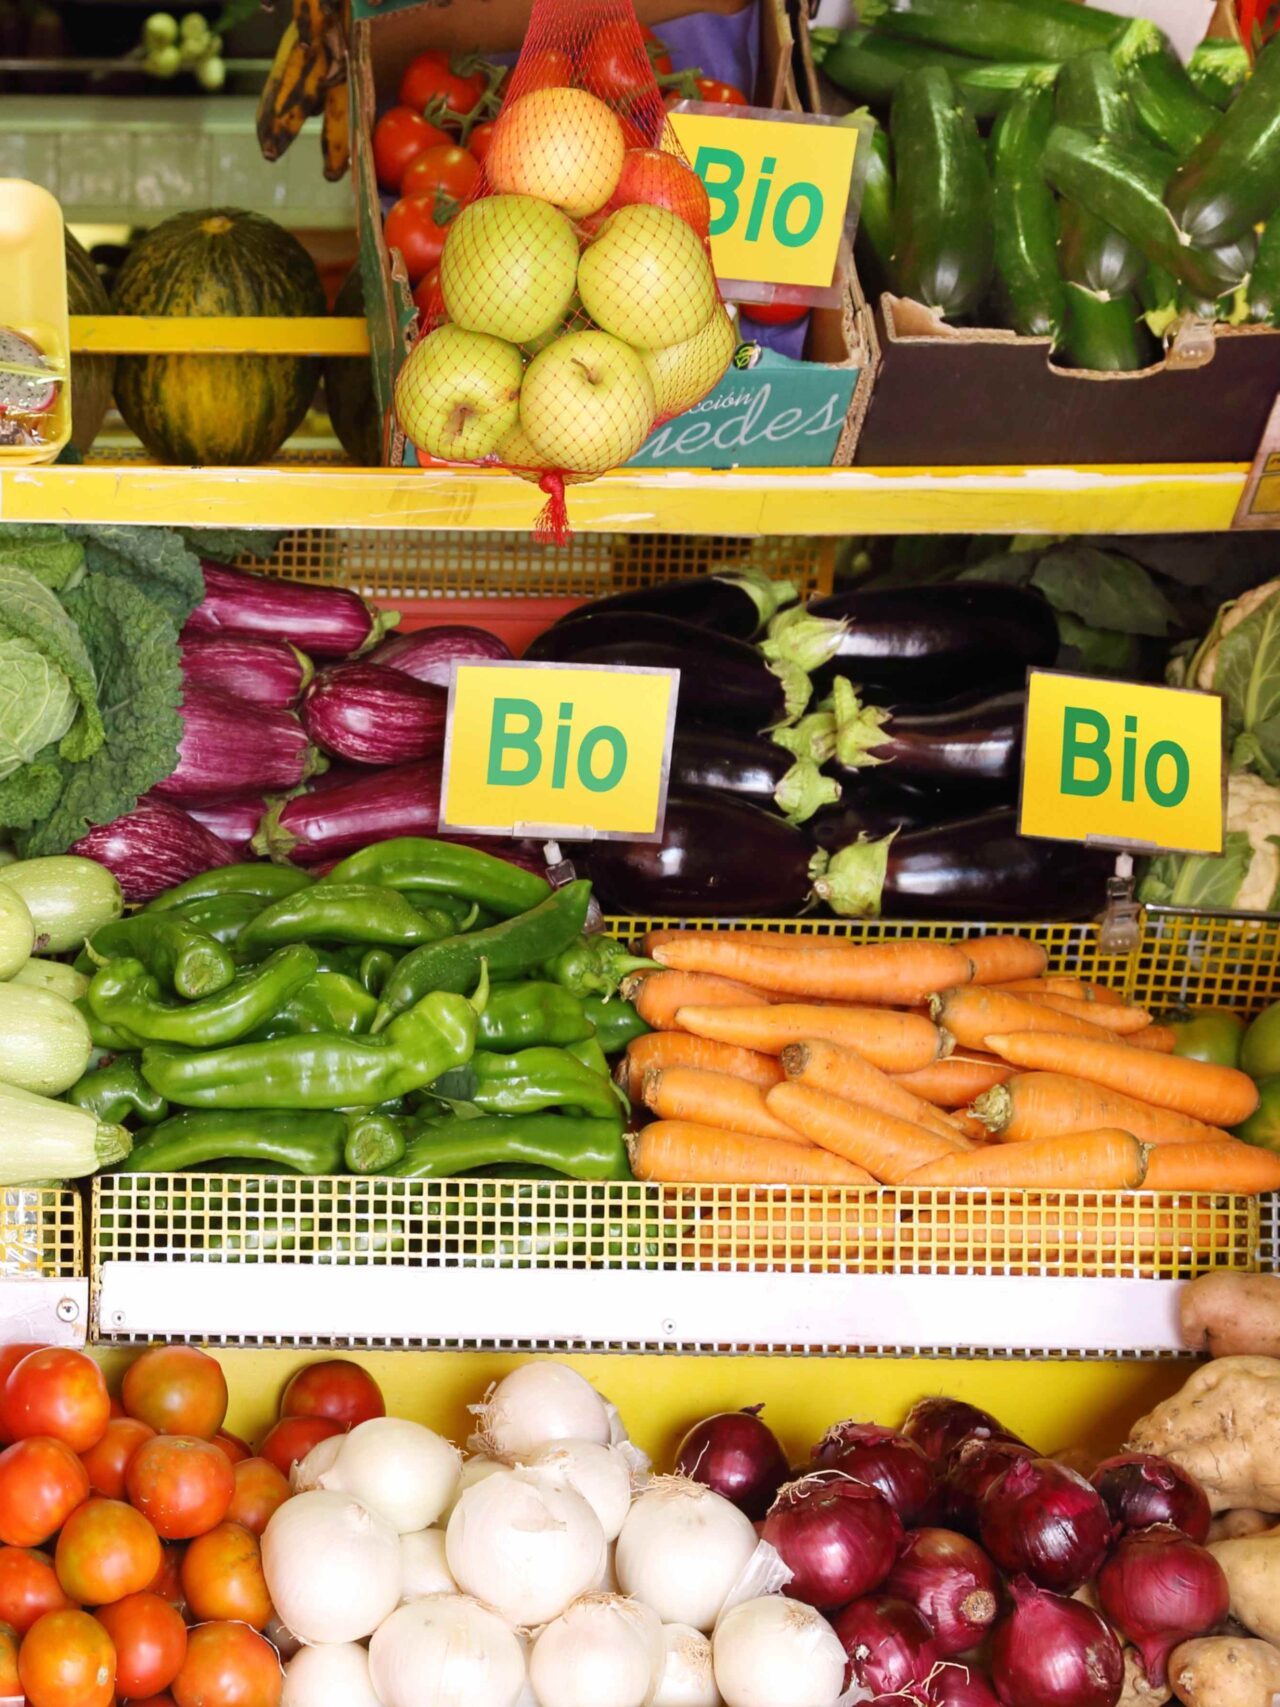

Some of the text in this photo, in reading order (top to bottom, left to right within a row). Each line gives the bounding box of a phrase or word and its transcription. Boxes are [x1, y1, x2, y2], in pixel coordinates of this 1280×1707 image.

[693, 146, 824, 248] Bio
[487, 698, 628, 793] Bio
[1061, 707, 1190, 808] Bio
